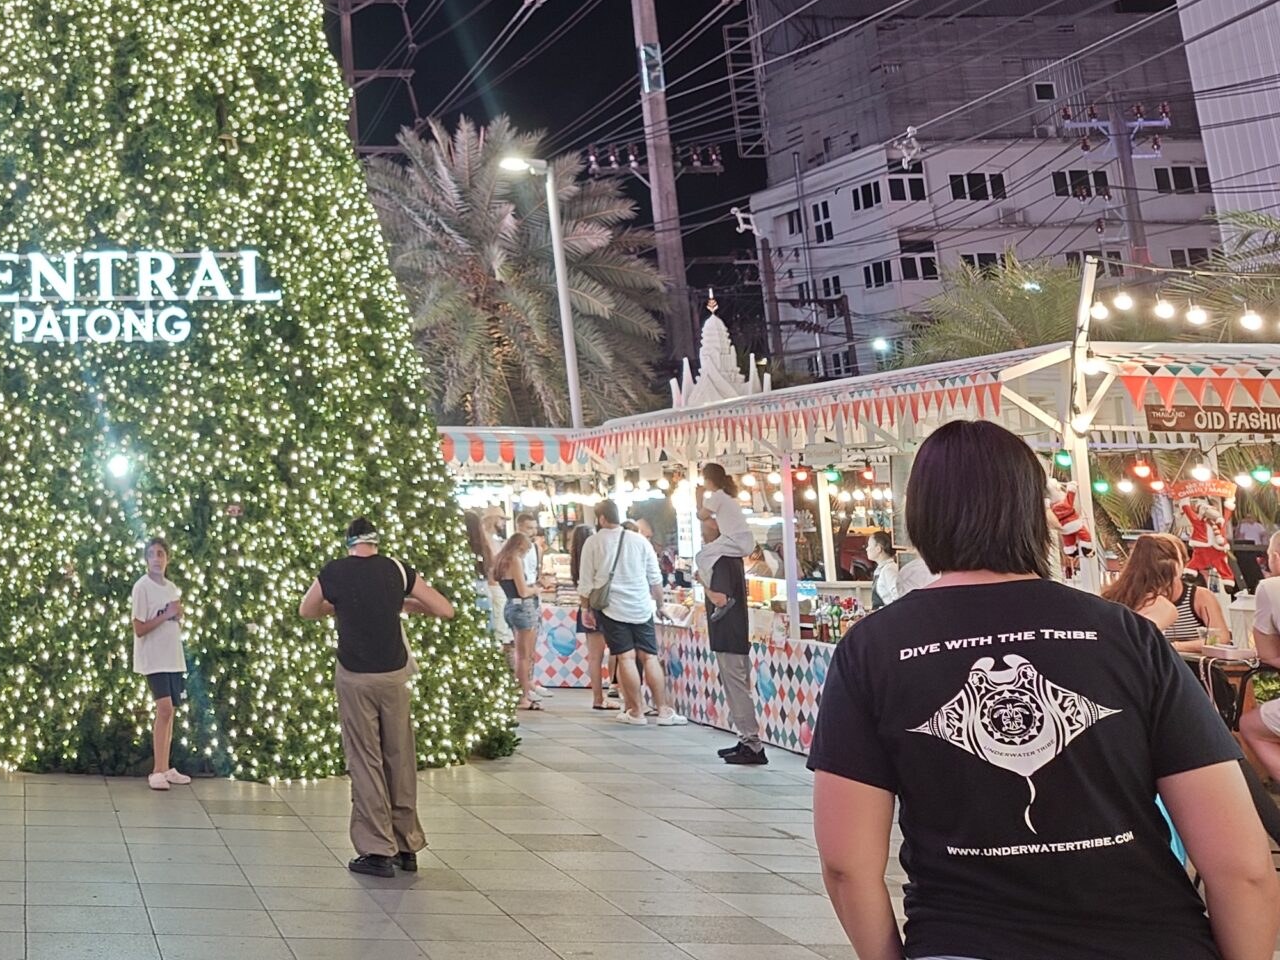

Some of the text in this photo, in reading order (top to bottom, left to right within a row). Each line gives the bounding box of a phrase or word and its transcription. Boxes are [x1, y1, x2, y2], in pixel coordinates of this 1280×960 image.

[13, 306, 192, 343] PATONG
[982, 738, 1056, 758] UNDERWATER TRIBE
